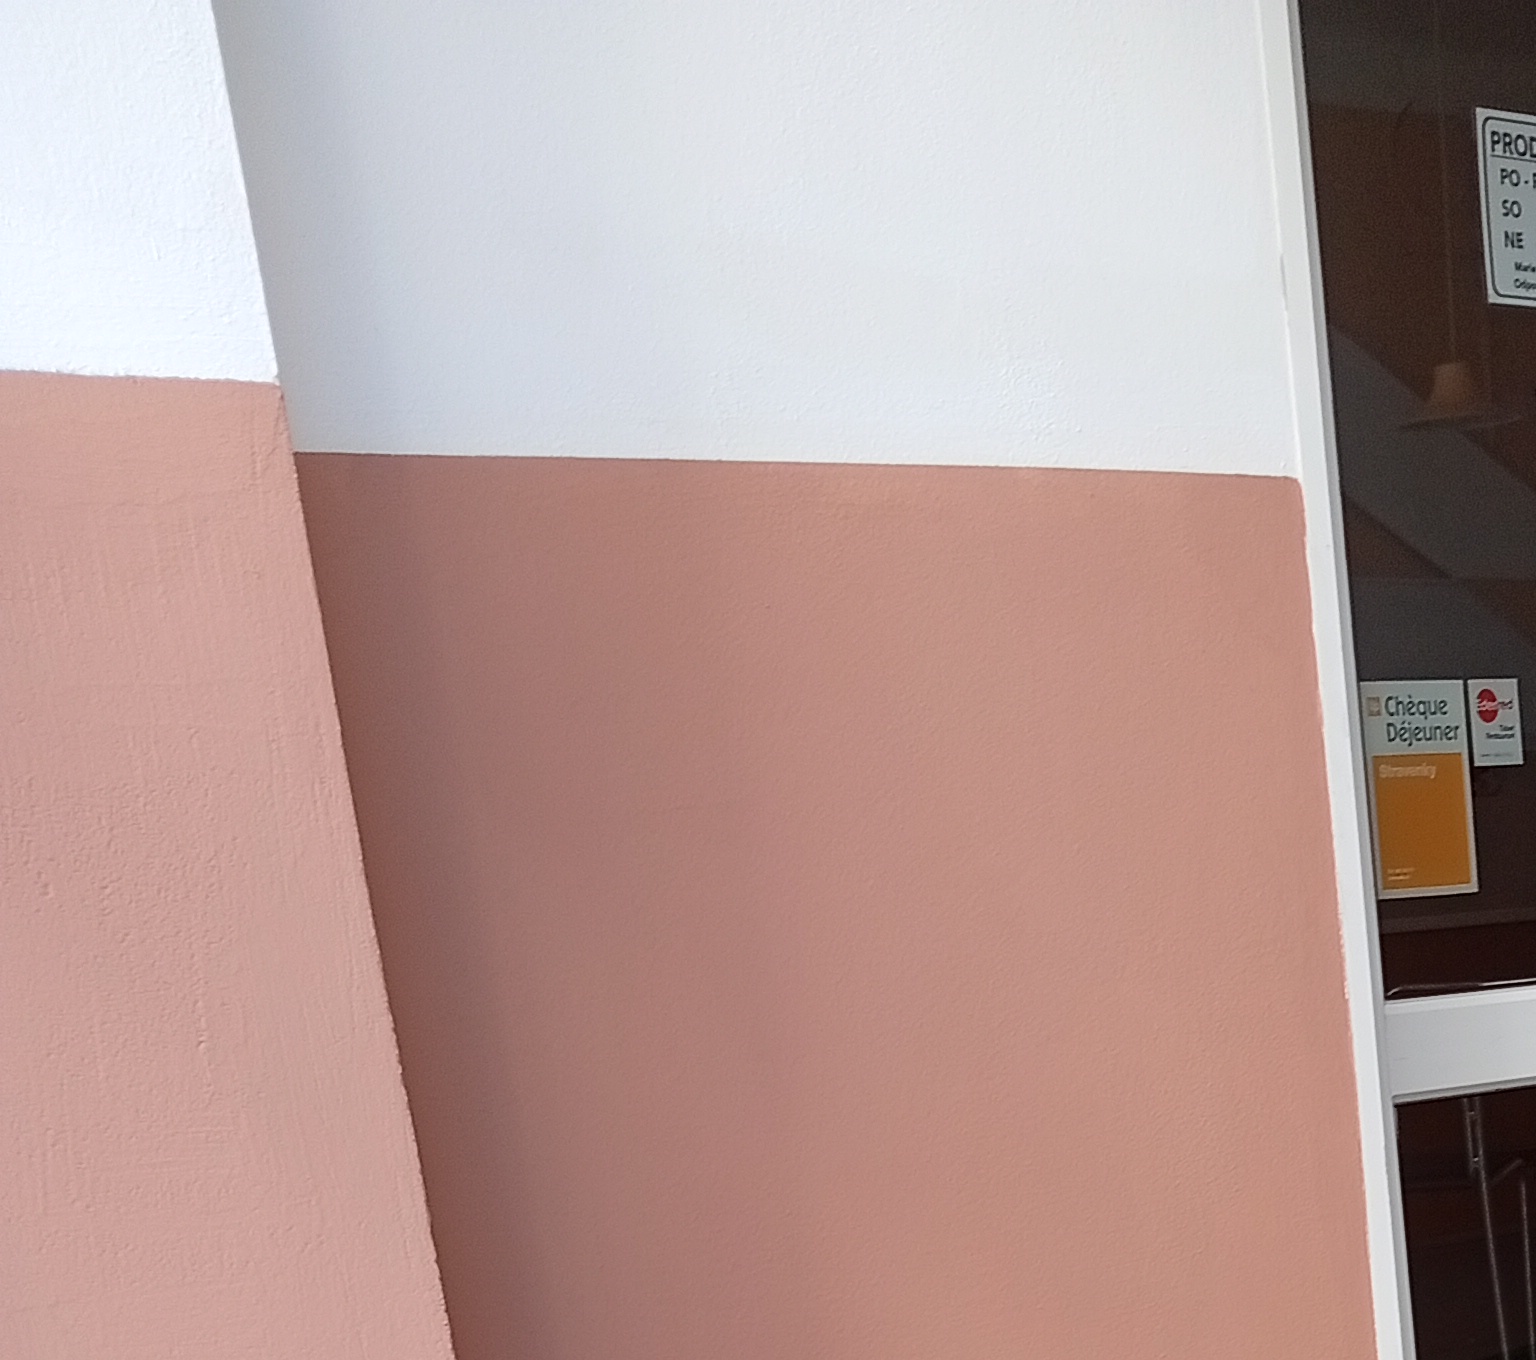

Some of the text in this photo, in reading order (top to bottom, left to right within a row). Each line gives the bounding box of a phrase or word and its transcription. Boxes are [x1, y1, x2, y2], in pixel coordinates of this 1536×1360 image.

[1500, 168, 1521, 187] PO
[1502, 199, 1522, 218] SO
[1504, 231, 1524, 249] NE
[1385, 695, 1448, 720] Chèque
[1387, 721, 1459, 746] Déjeuner
